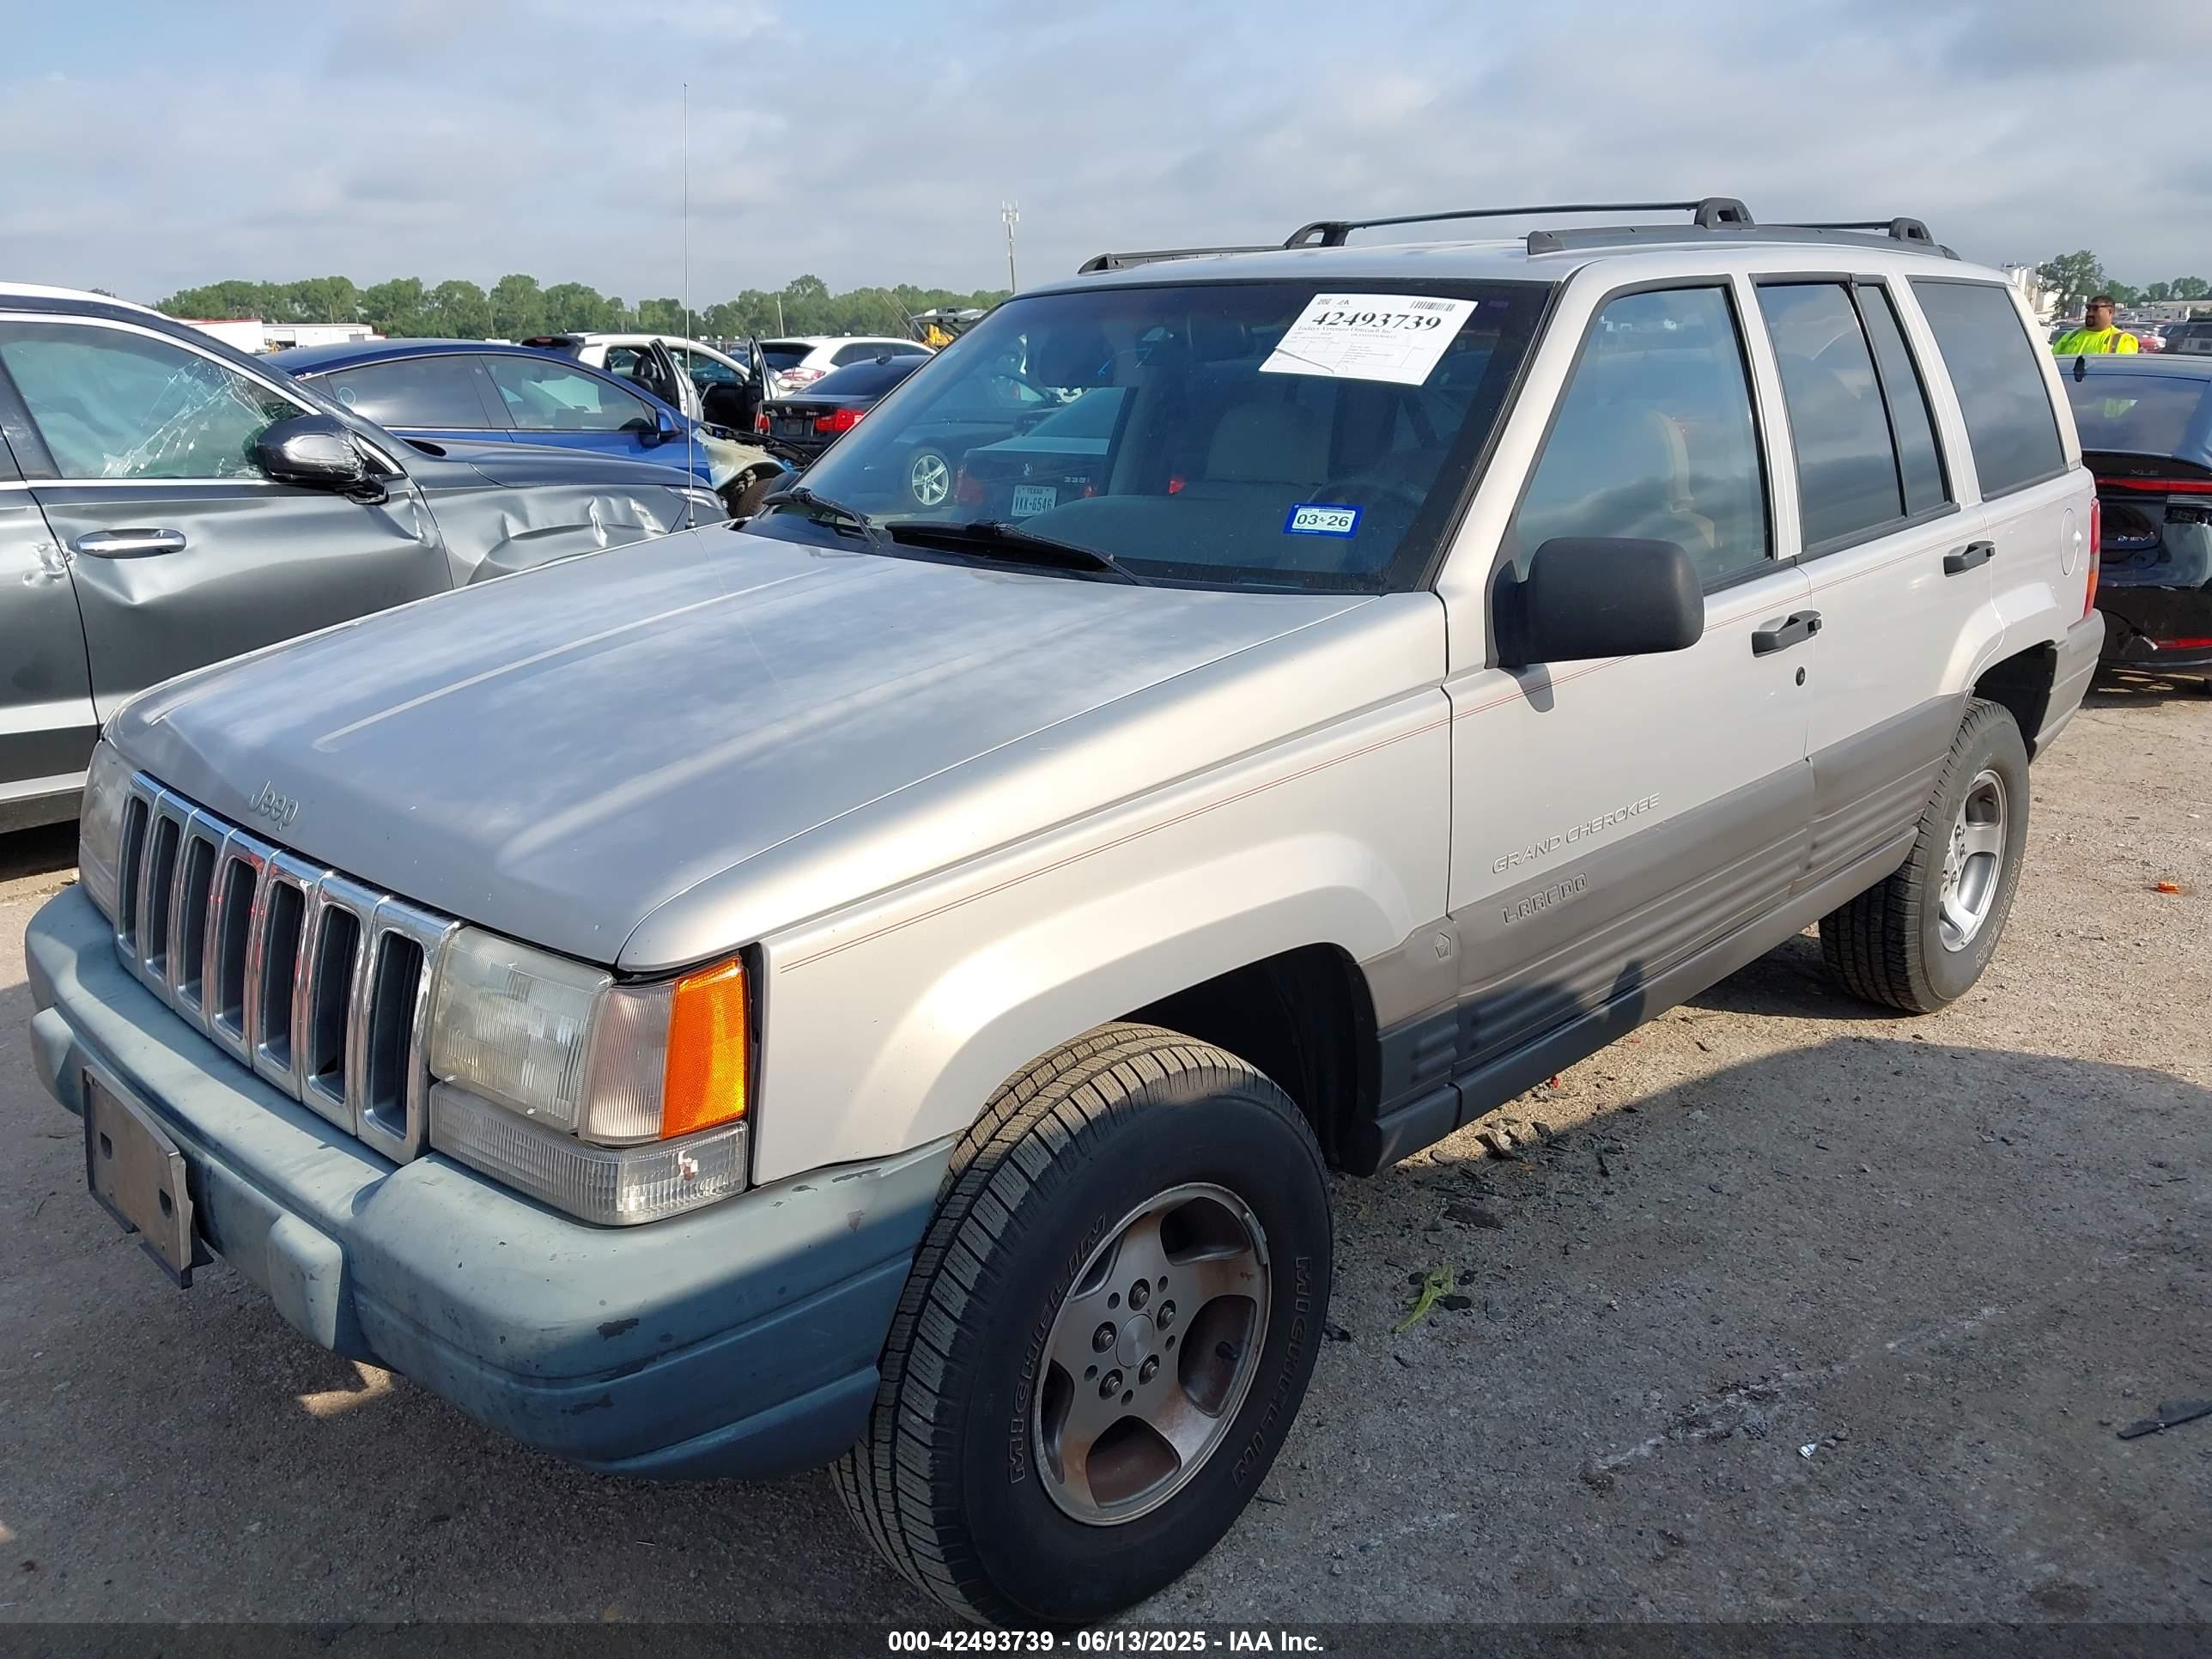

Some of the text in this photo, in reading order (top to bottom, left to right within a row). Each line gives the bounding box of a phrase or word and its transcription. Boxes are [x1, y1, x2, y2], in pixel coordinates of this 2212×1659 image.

[1312, 311, 1442, 331] 42493739
[247, 780, 299, 831] Jeep
[1492, 792, 1661, 874] GRAND CHEROKEE
[1975, 858, 2021, 969] MICHELIN
[1010, 1214, 1106, 1485] MICHELIN
[1233, 1256, 1312, 1488] MICHELIN
